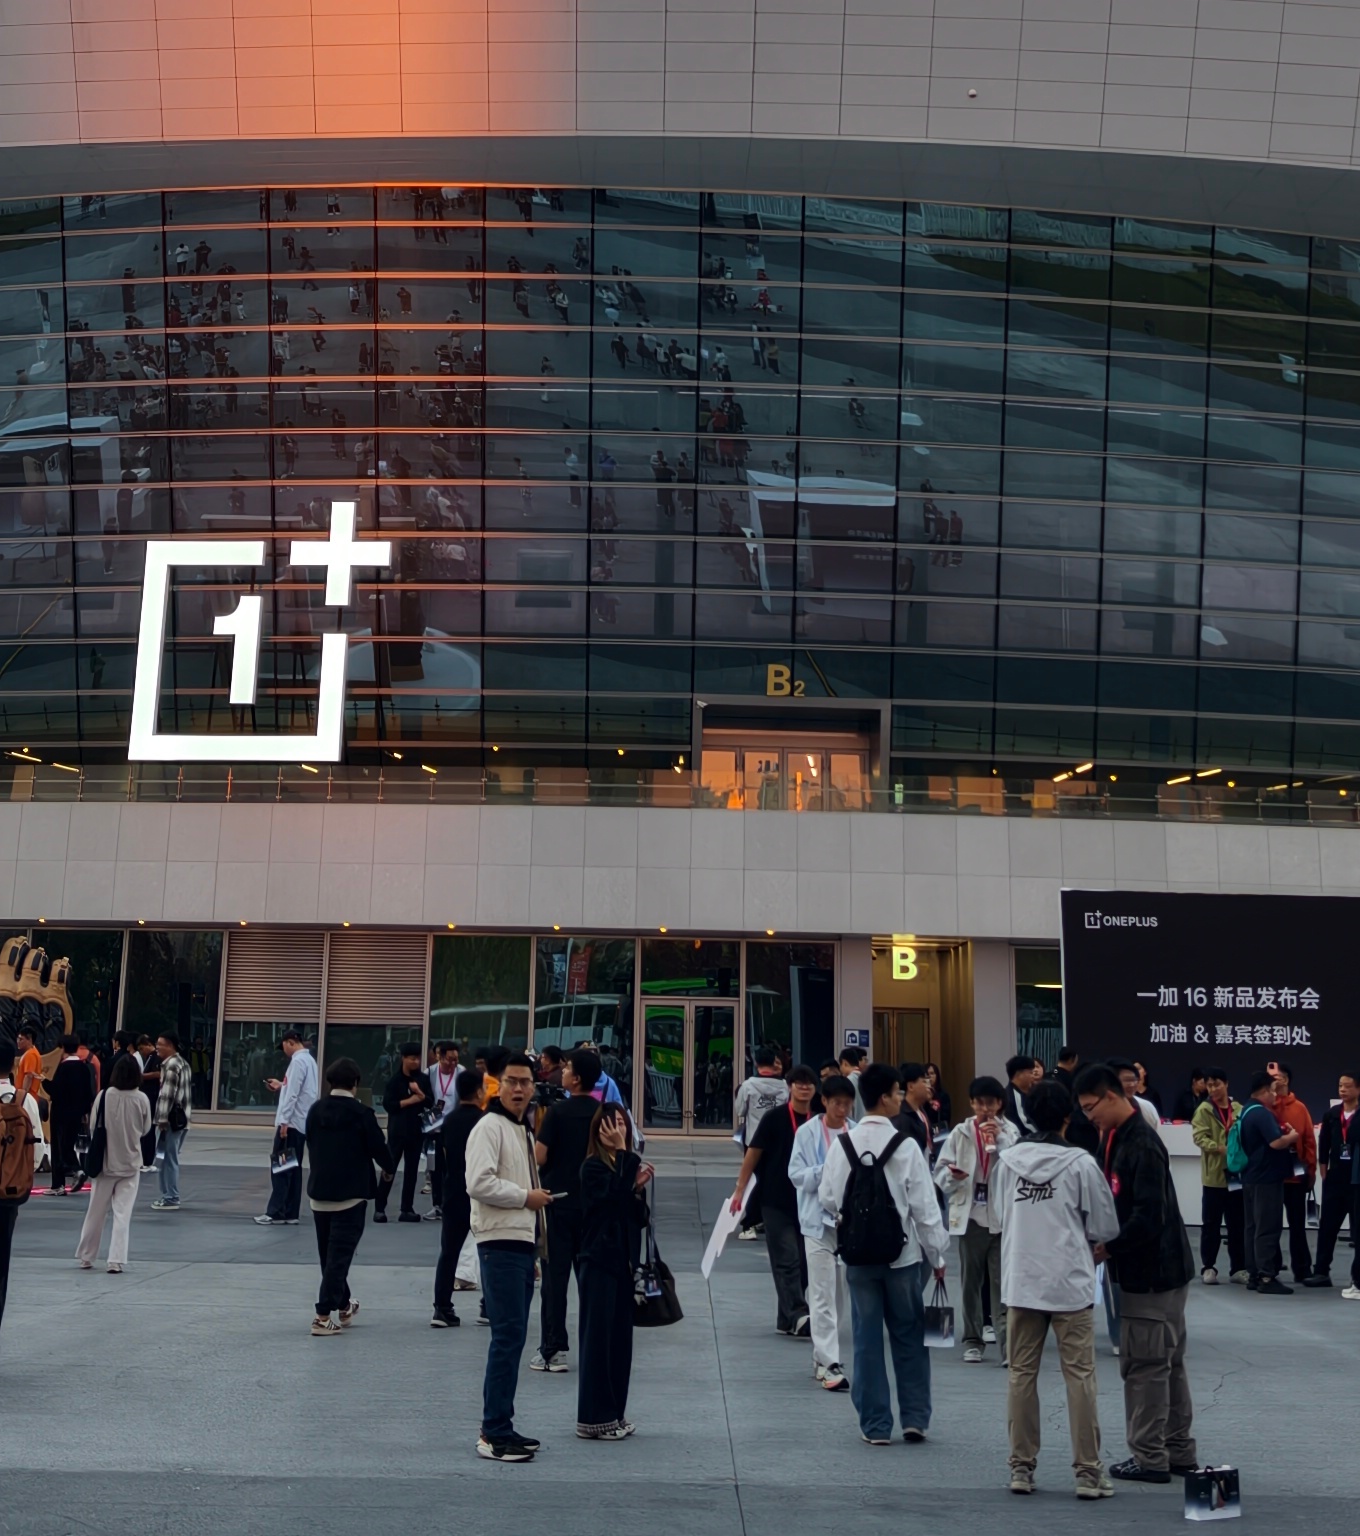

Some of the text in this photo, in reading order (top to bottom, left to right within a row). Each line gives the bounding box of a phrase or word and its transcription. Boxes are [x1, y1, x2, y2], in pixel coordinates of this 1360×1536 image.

[766, 663, 805, 697] B2
[1102, 915, 1159, 928] ONEPLUS
[892, 945, 918, 980] B
[1136, 985, 1320, 1010] 一加 16 新品发布会
[1149, 1022, 1312, 1046] 加油 & 嘉宾签到处
